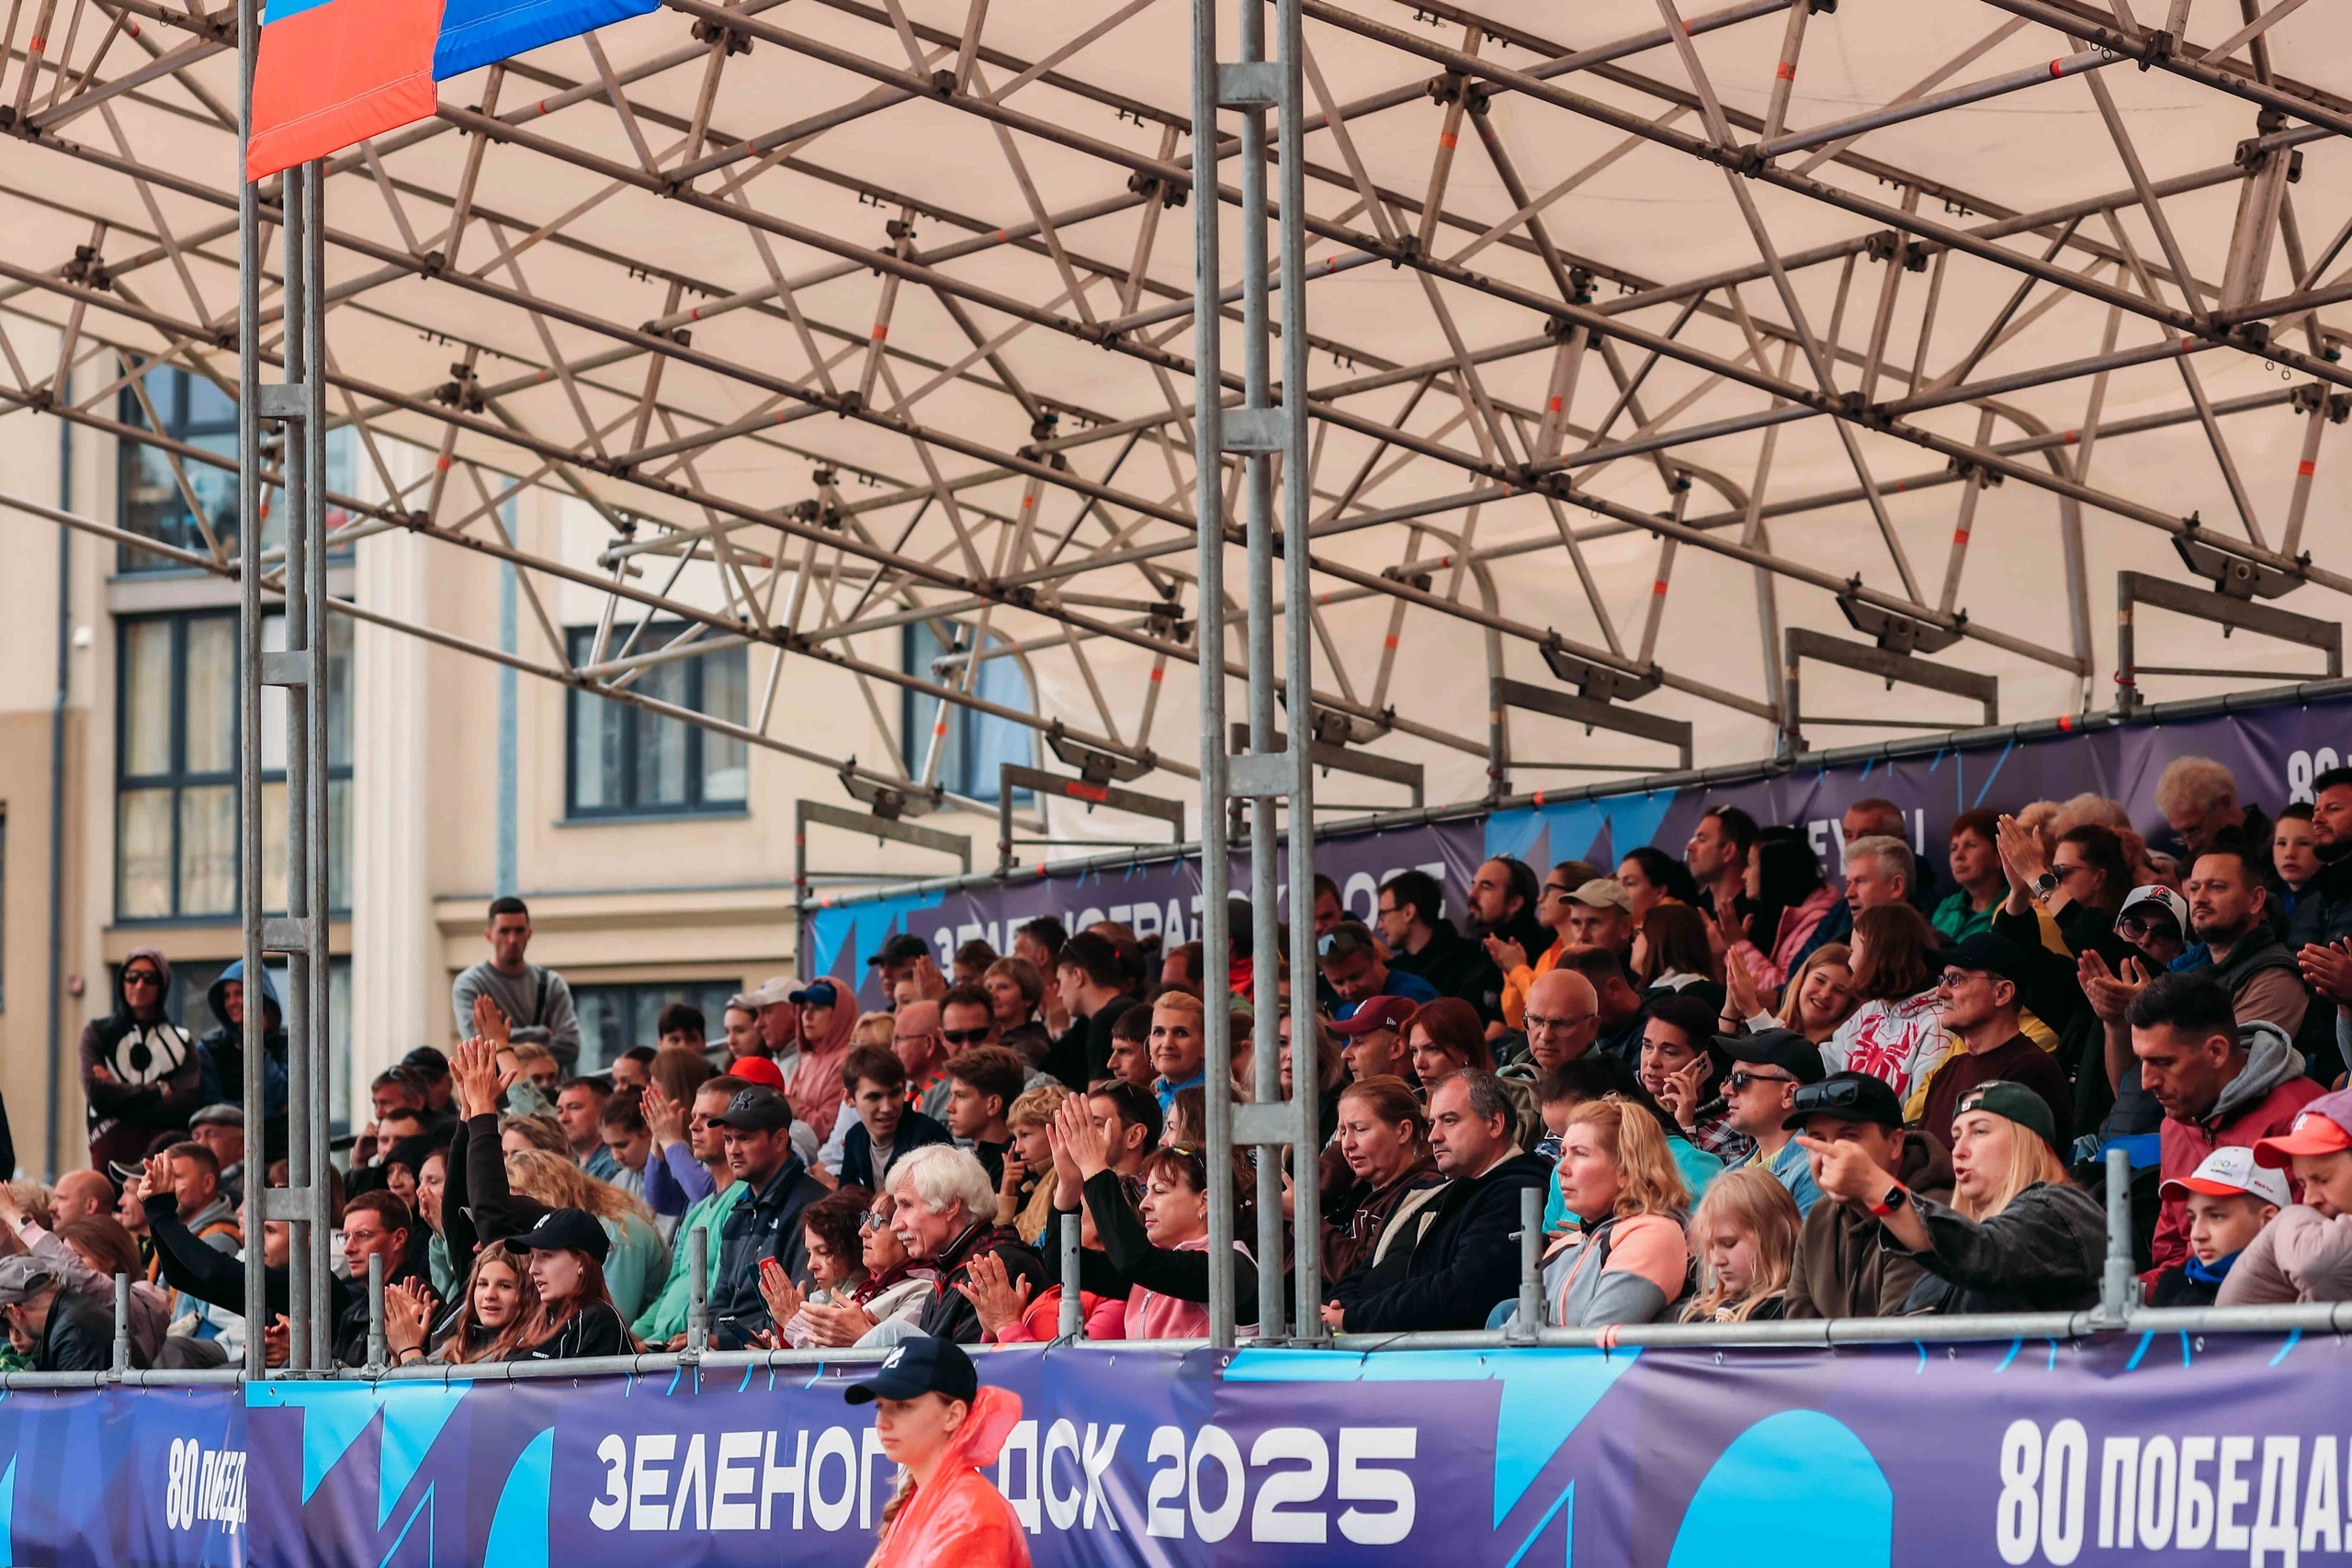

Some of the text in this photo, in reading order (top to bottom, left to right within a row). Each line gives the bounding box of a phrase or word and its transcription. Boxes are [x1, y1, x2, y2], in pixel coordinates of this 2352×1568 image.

[166, 1438, 199, 1530] 80
[589, 1418, 1417, 1545] ЗЕЛЕНОГДСК 2025
[1996, 1418, 2088, 1566] 80
